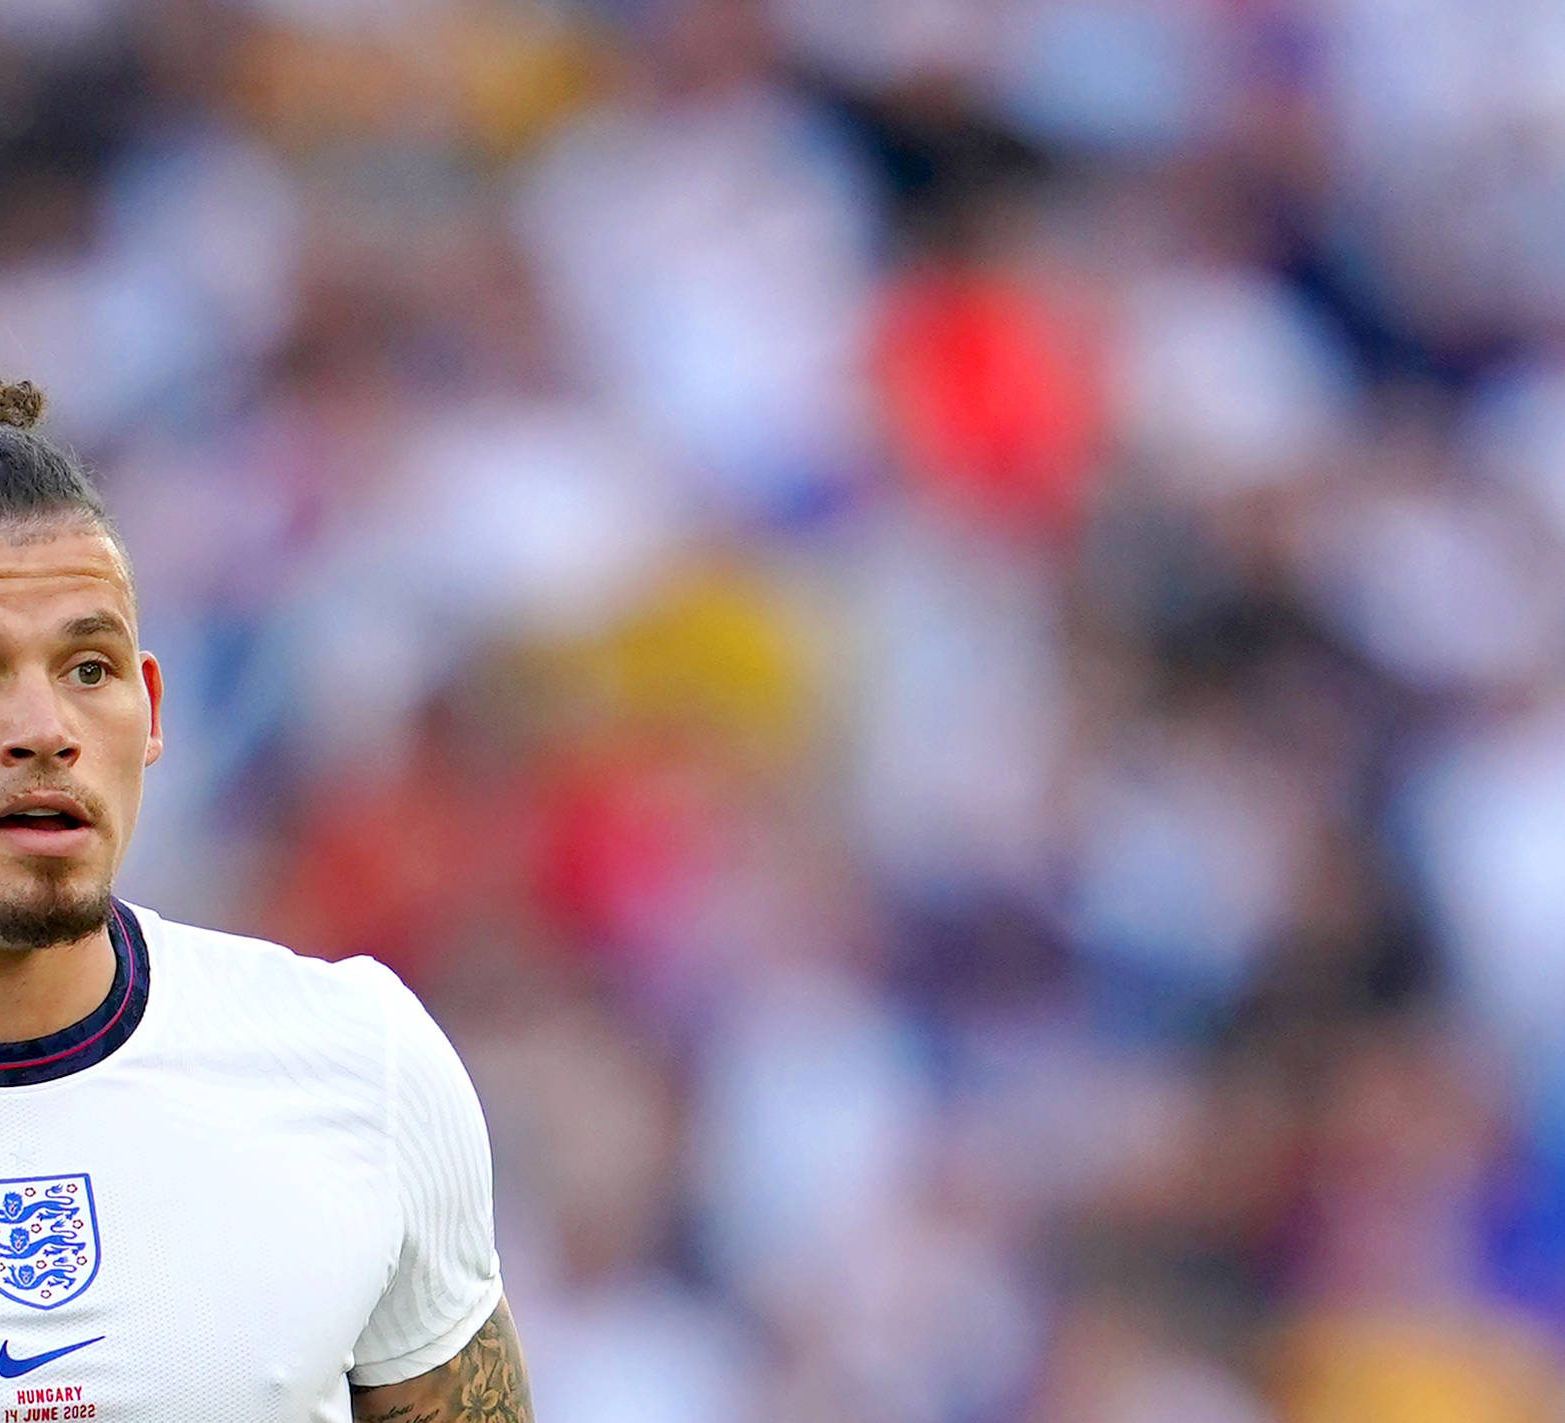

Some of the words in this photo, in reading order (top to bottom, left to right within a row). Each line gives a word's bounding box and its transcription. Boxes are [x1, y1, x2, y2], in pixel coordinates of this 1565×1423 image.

[17, 1386, 82, 1404] HUNGARY
[4, 1409, 18, 1423] 14
[23, 1407, 58, 1422] JUNE
[63, 1404, 95, 1419] 2022
